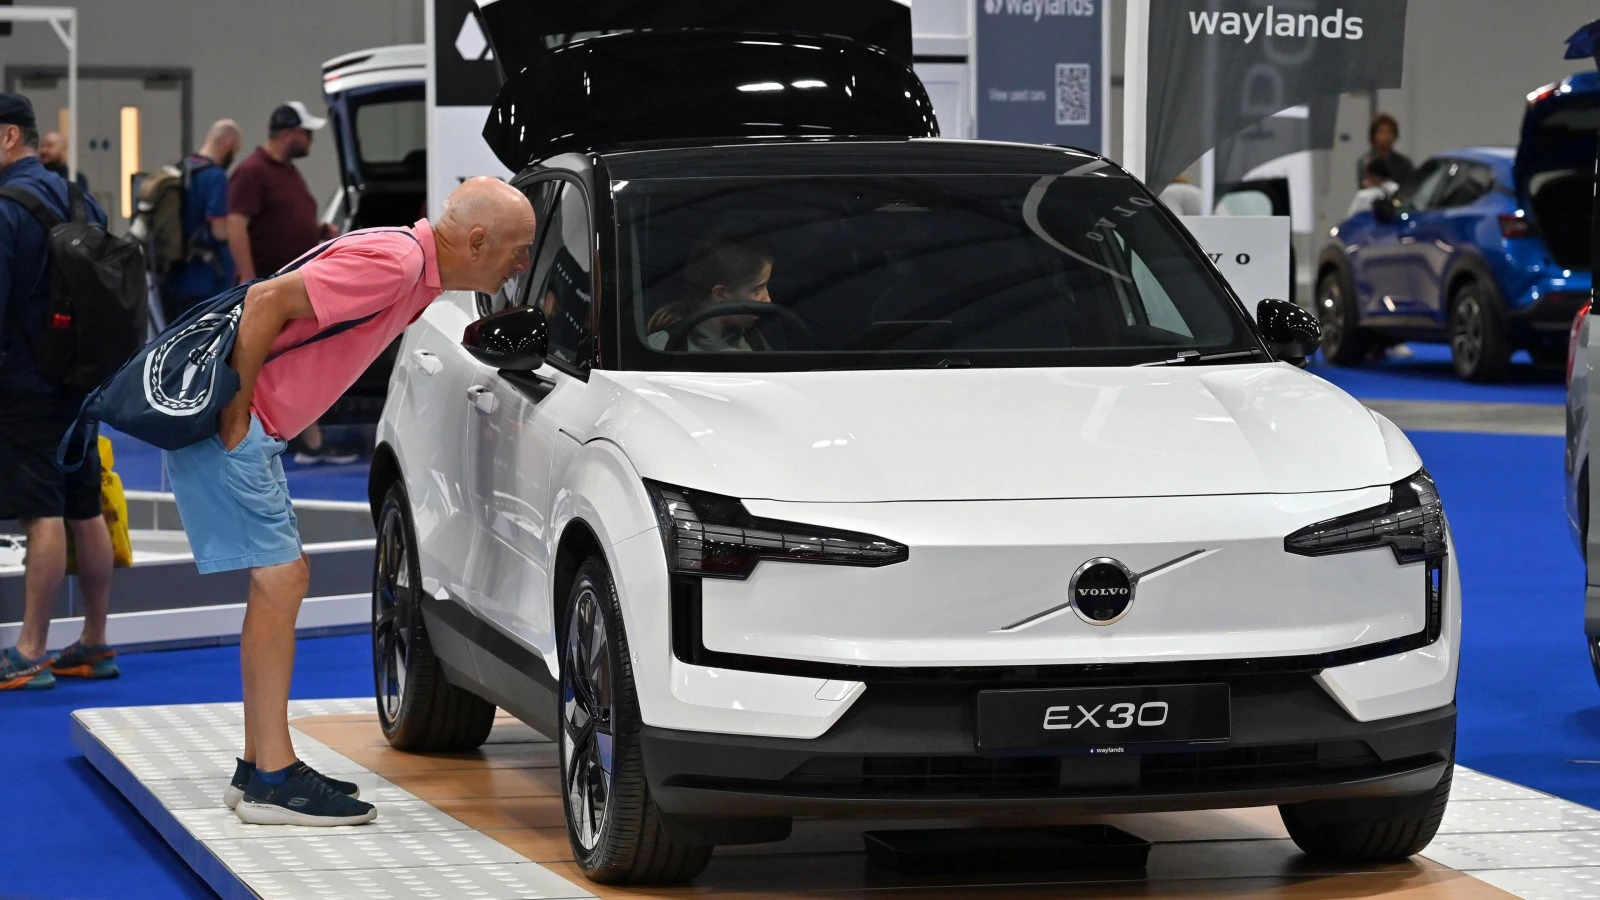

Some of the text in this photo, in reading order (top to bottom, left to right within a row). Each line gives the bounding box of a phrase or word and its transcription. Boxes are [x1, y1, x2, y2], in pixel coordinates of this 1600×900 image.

[1189, 5, 1363, 44] waylands
[1078, 587, 1128, 596] VOLVO
[1043, 701, 1169, 730] EX30
[1096, 747, 1125, 755] waylands
